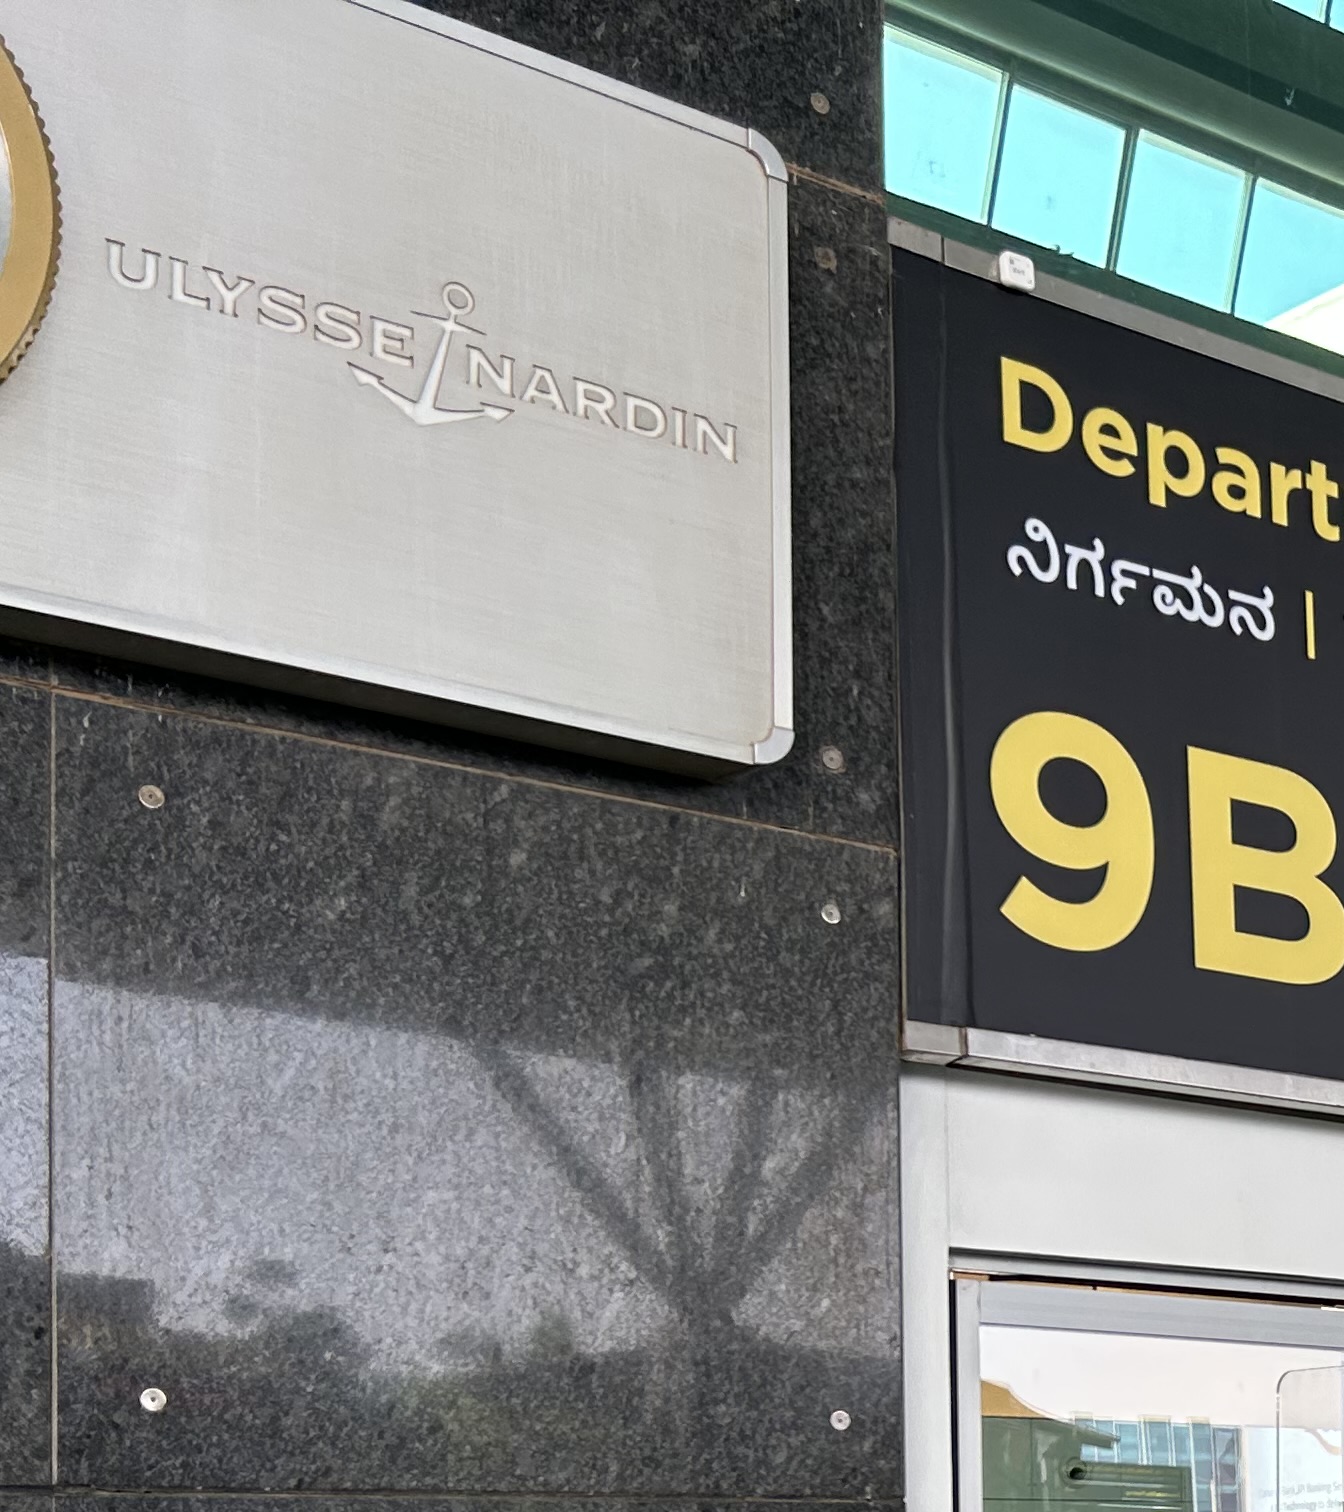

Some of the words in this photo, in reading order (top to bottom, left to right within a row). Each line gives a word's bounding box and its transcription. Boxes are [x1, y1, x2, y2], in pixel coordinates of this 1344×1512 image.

[104, 238, 416, 368] ULYSSE
[465, 344, 740, 465] NARDIN
[1006, 516, 1276, 643] ನಿರ್ಗಮನ
